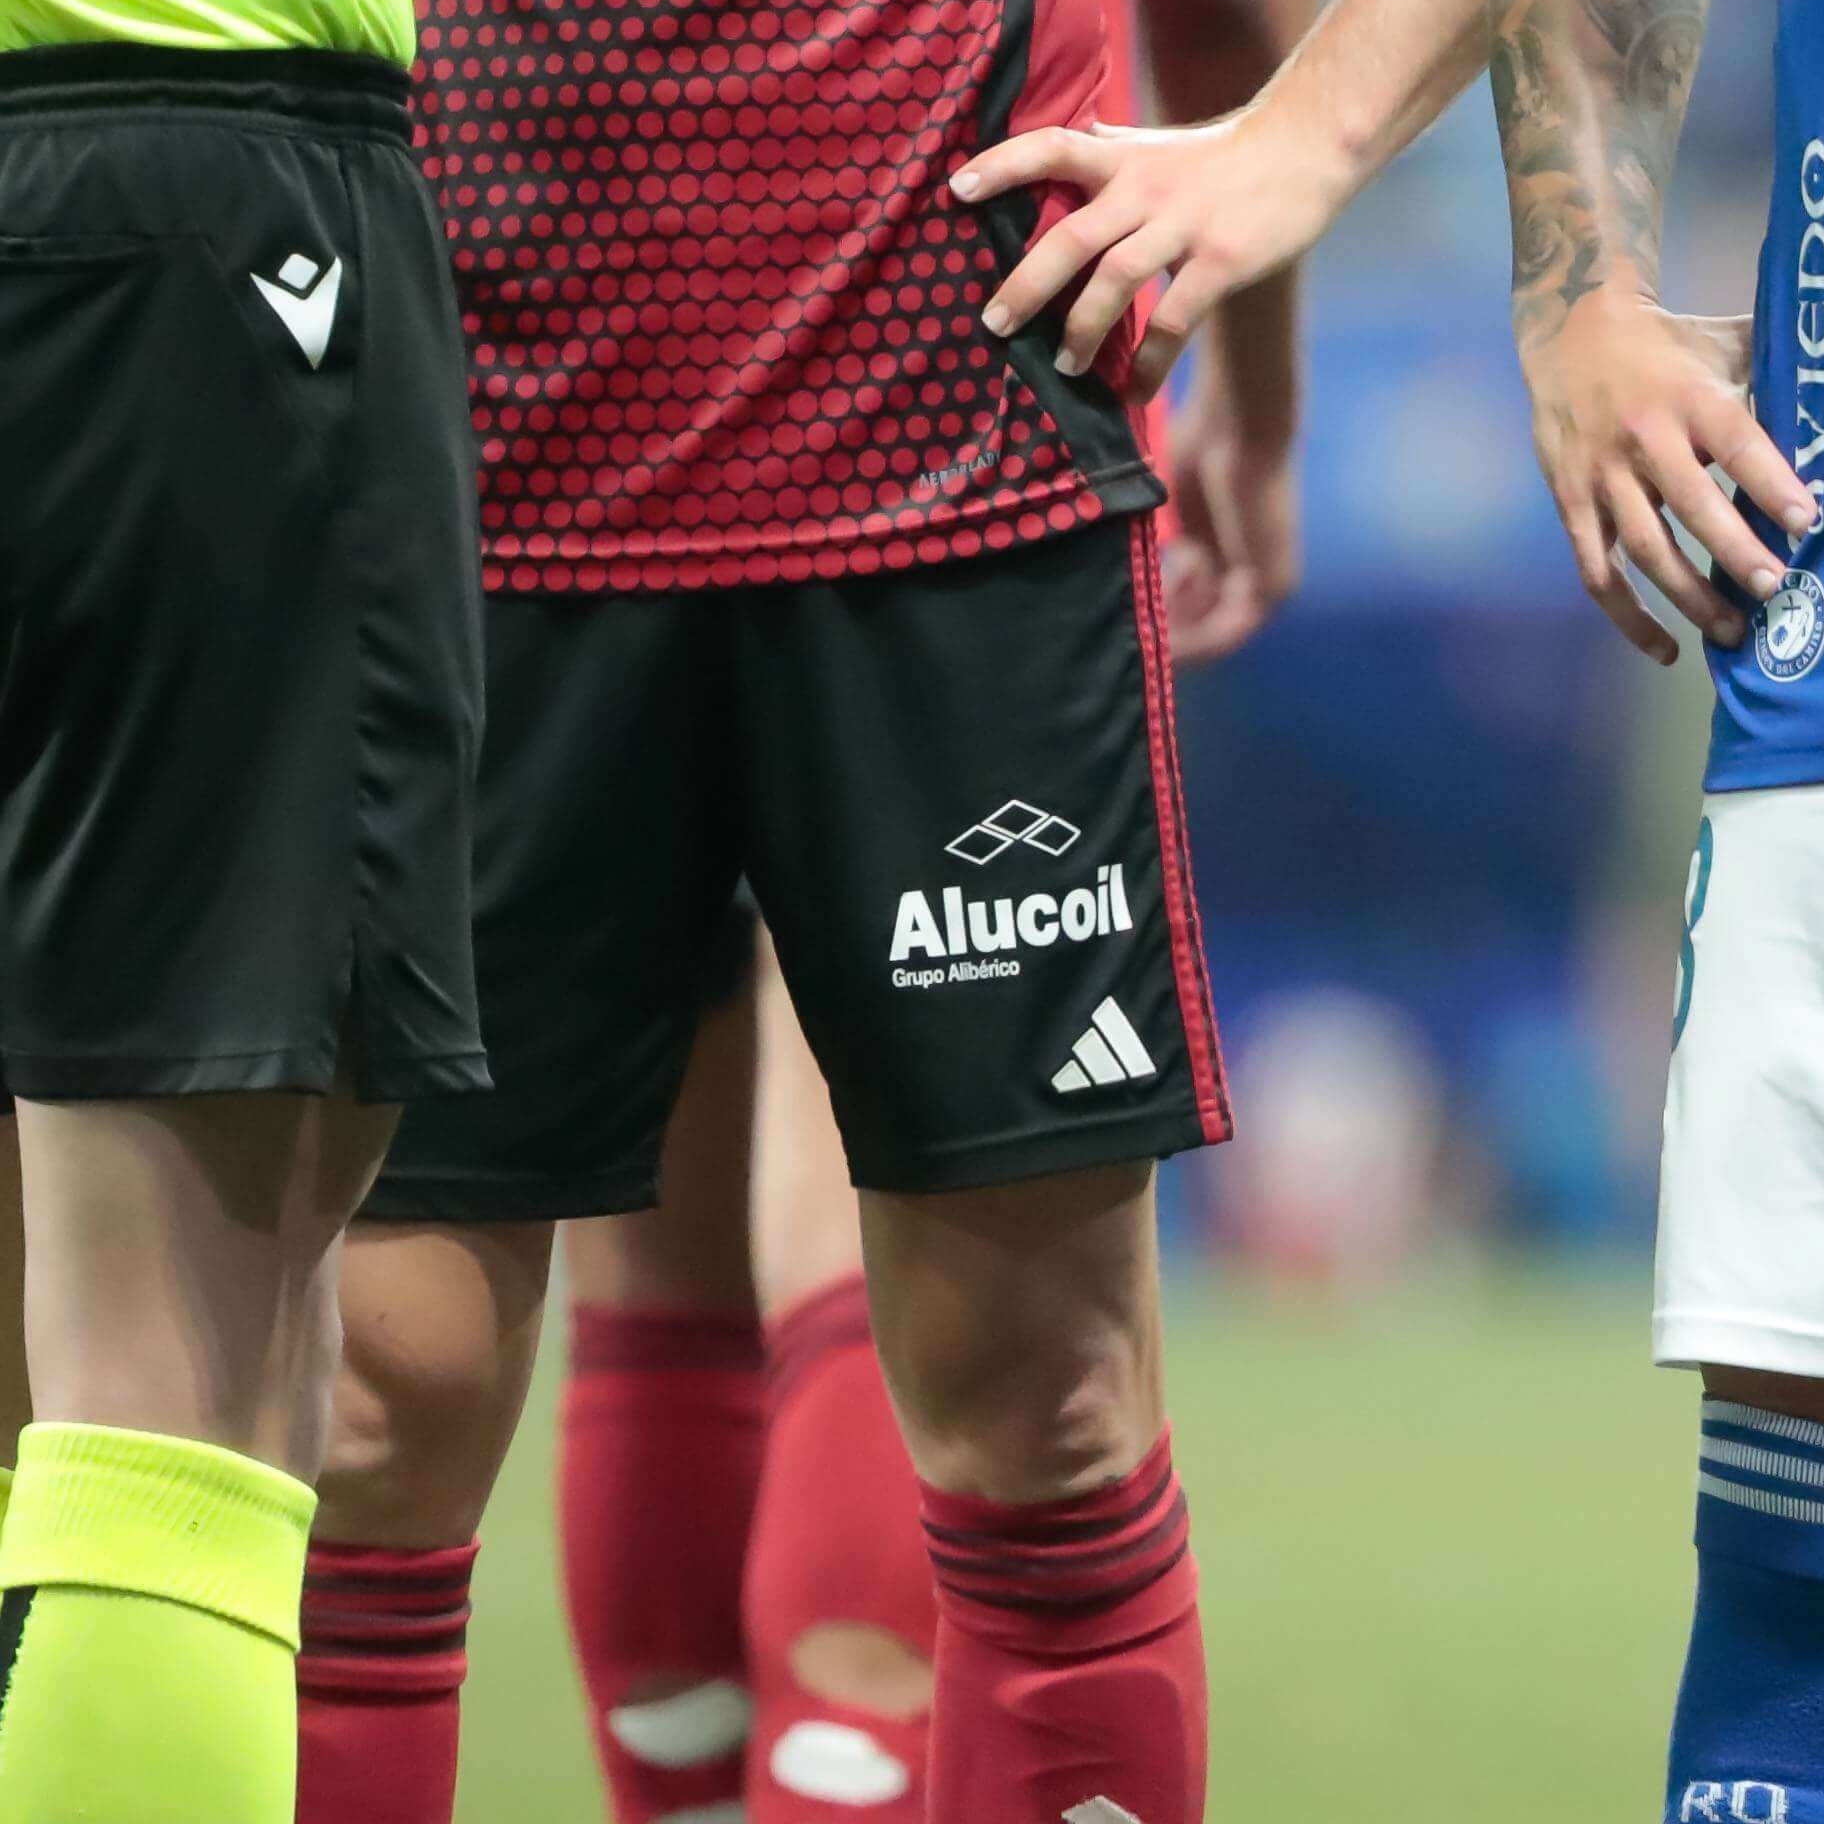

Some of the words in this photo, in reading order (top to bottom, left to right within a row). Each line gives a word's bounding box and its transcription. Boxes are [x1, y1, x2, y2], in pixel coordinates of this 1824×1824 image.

[889, 863, 1133, 961] Alucoil
[892, 968, 944, 989] Grupo
[948, 959, 1020, 983] Alibérico
